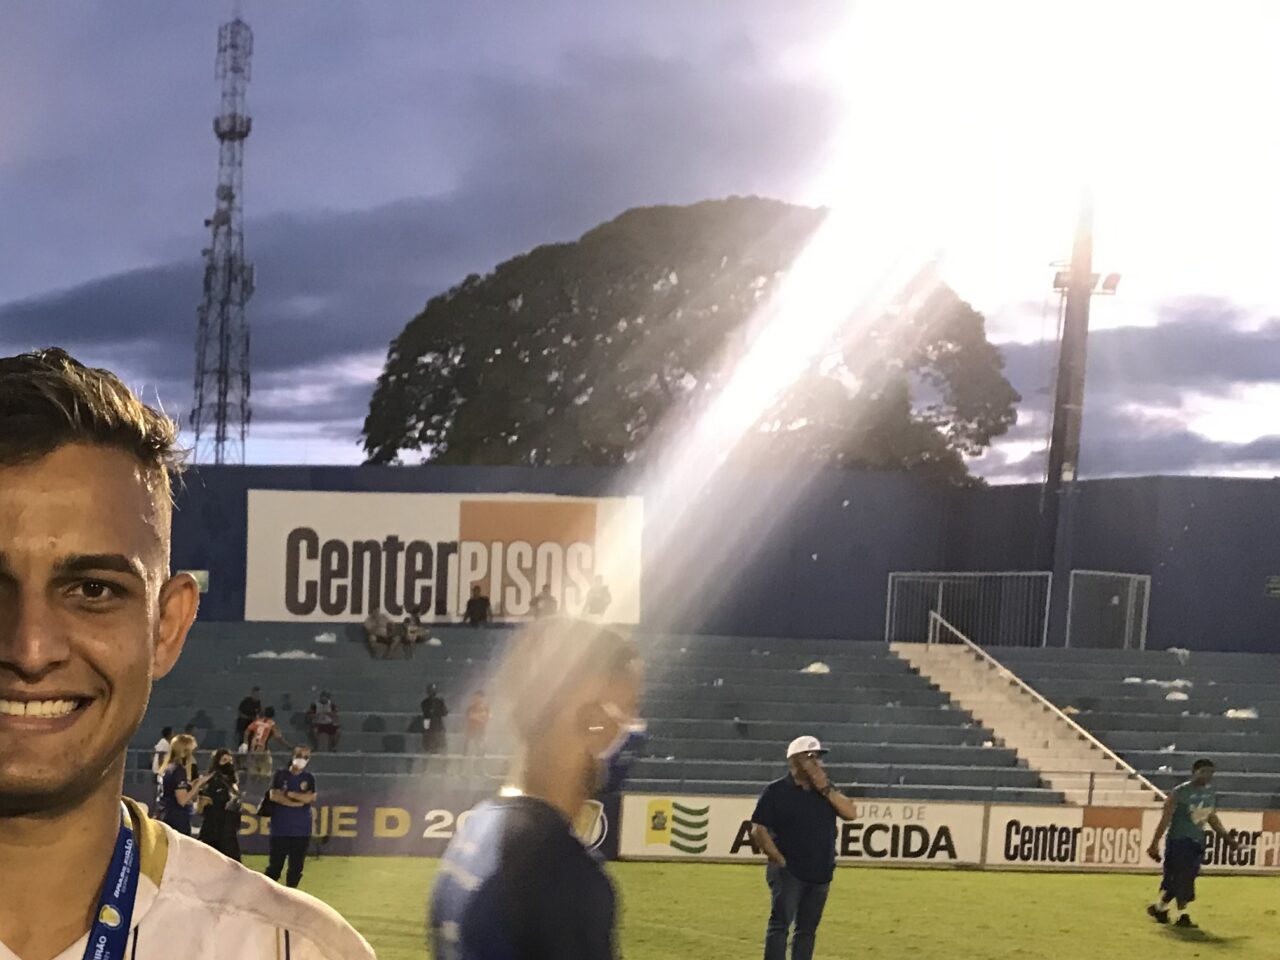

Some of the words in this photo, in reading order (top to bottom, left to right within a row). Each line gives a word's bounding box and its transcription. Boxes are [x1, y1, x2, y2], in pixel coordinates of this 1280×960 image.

[373, 806, 411, 838] D
[902, 805, 927, 820] DE
[1004, 819, 1142, 864] CenterPISOS
